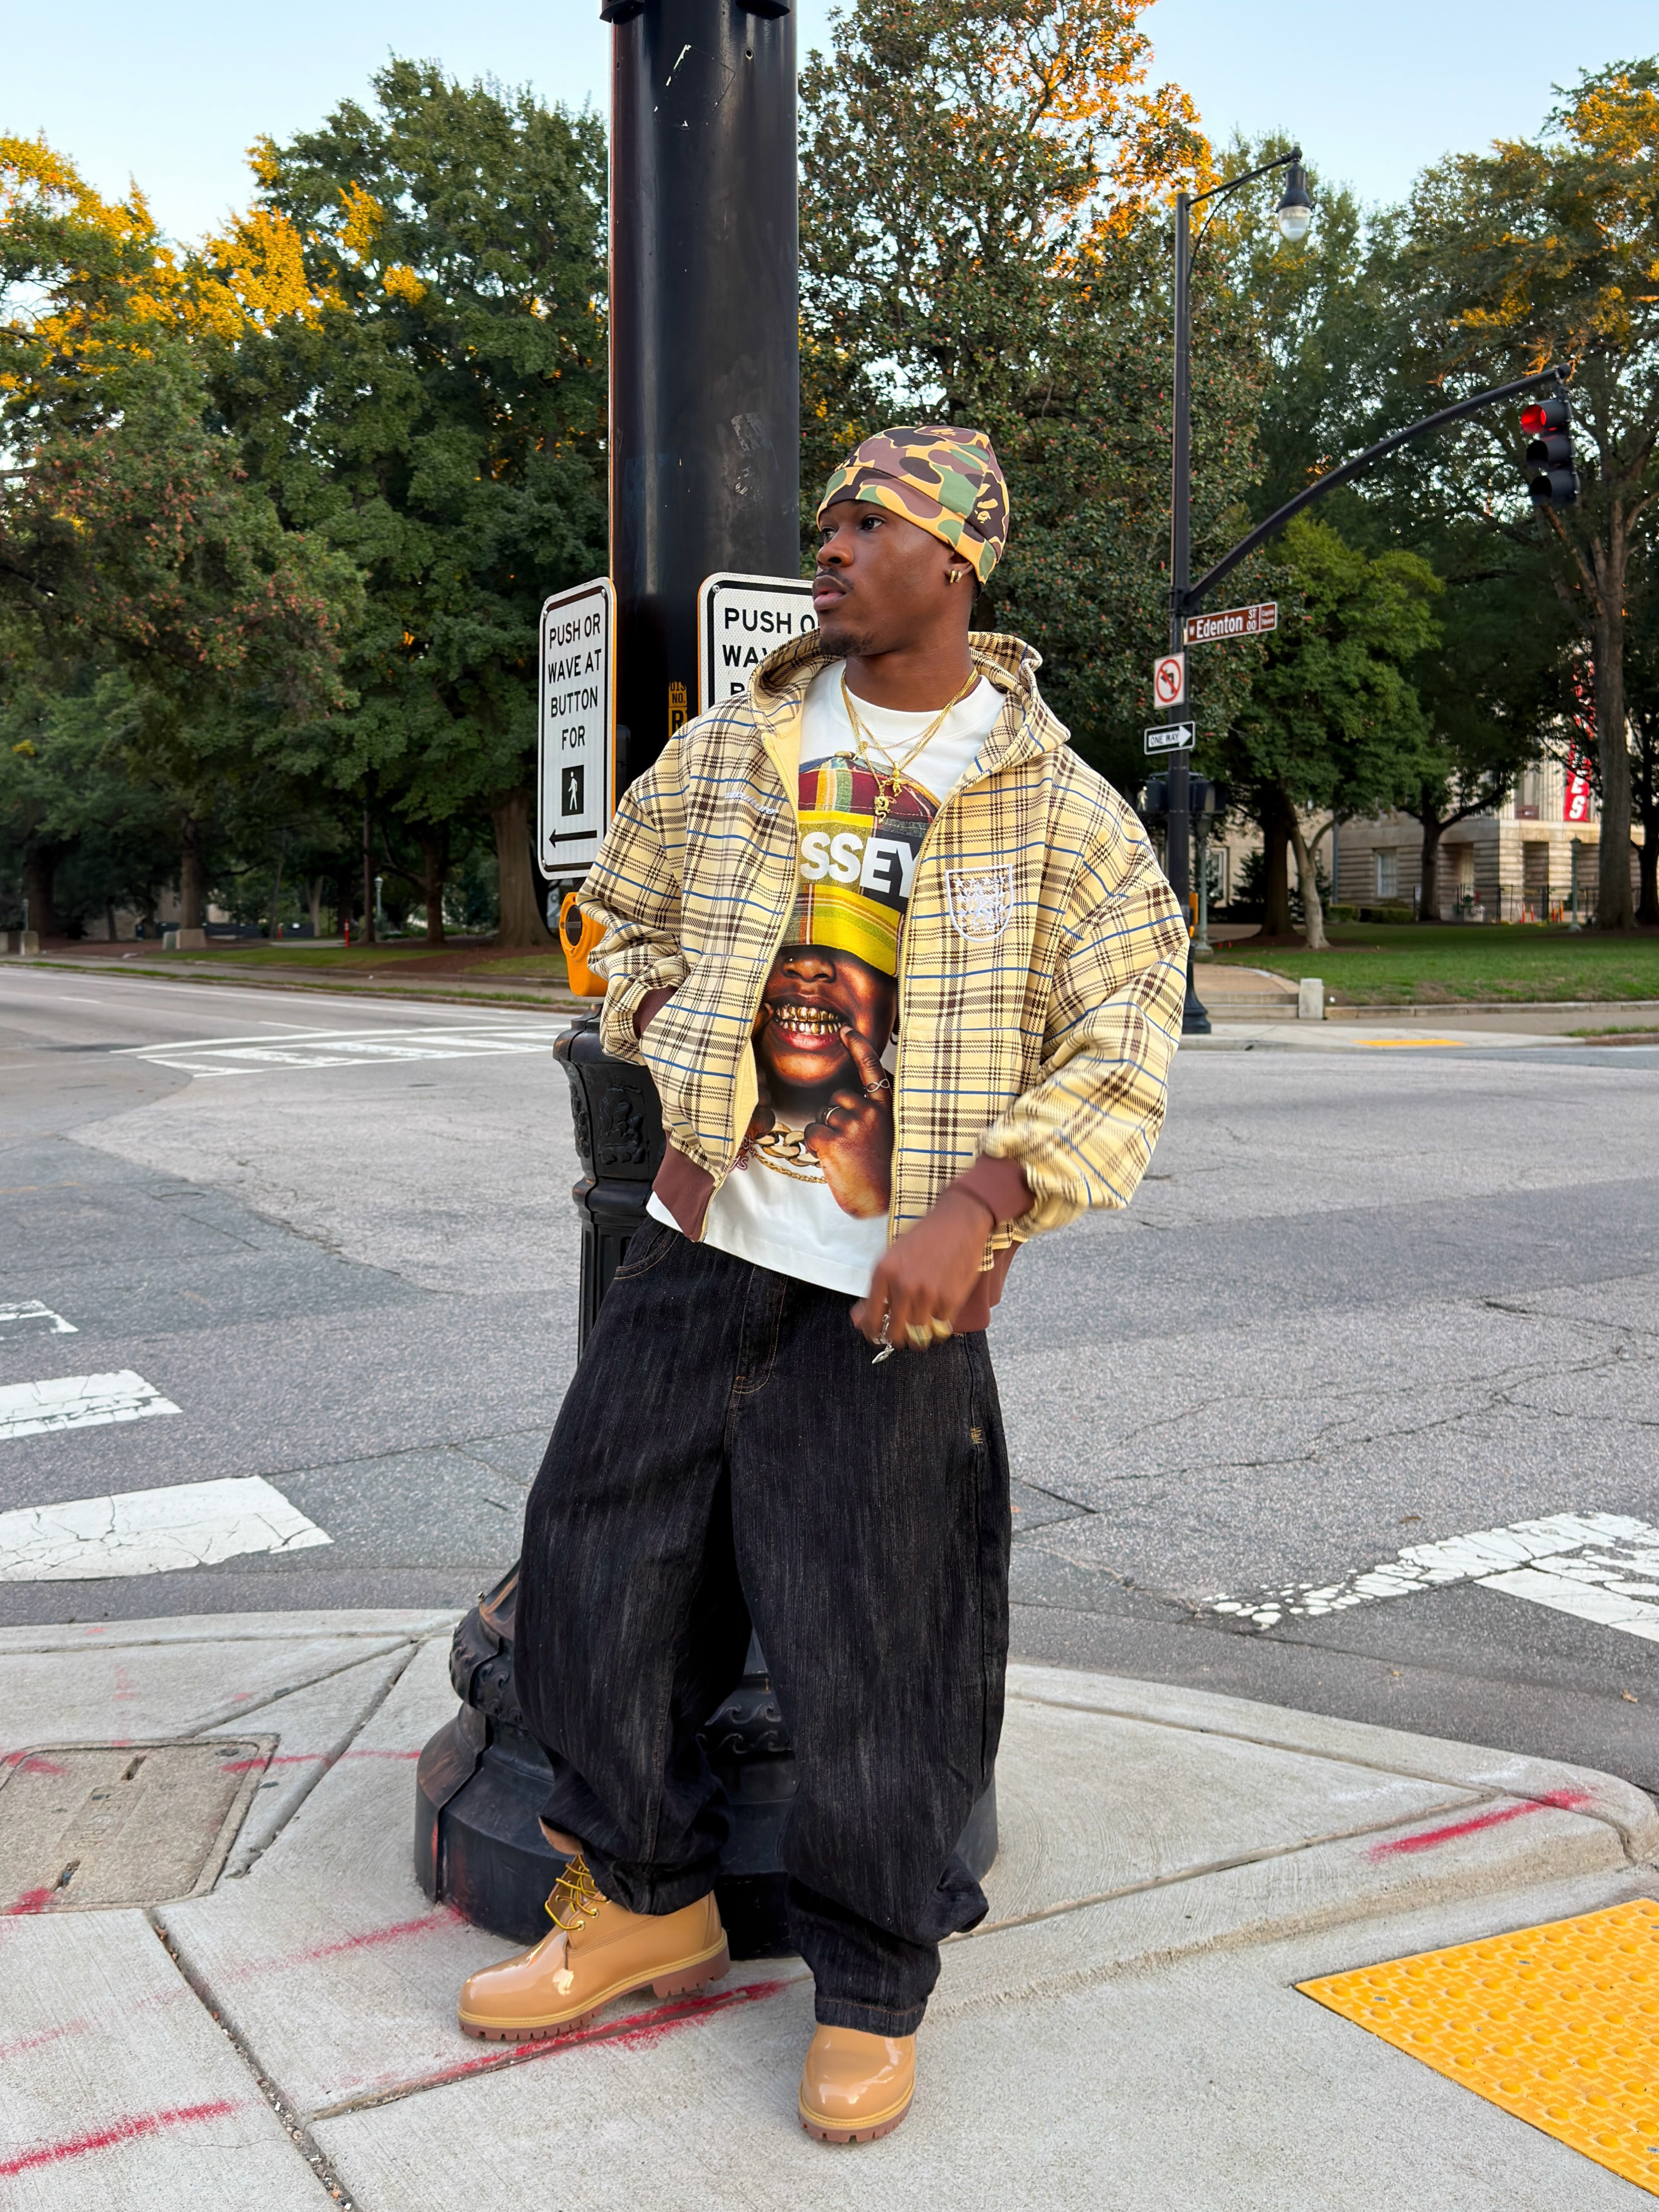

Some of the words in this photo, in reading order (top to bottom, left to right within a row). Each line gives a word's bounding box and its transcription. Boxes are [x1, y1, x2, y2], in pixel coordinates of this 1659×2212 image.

[724, 607, 792, 635] PUSH
[800, 614, 820, 632] O
[1196, 615, 1244, 639] Edenton
[1248, 609, 1257, 620] ST
[550, 619, 581, 650] PUSH
[584, 613, 601, 638] OR
[548, 655, 582, 684] WAVE
[585, 648, 602, 674] AT
[551, 685, 598, 718] BUTTON
[672, 693, 686, 704] NO.
[562, 725, 585, 751] FOR
[1150, 735, 1164, 746] ONE
[1165, 732, 1179, 743] WAY
